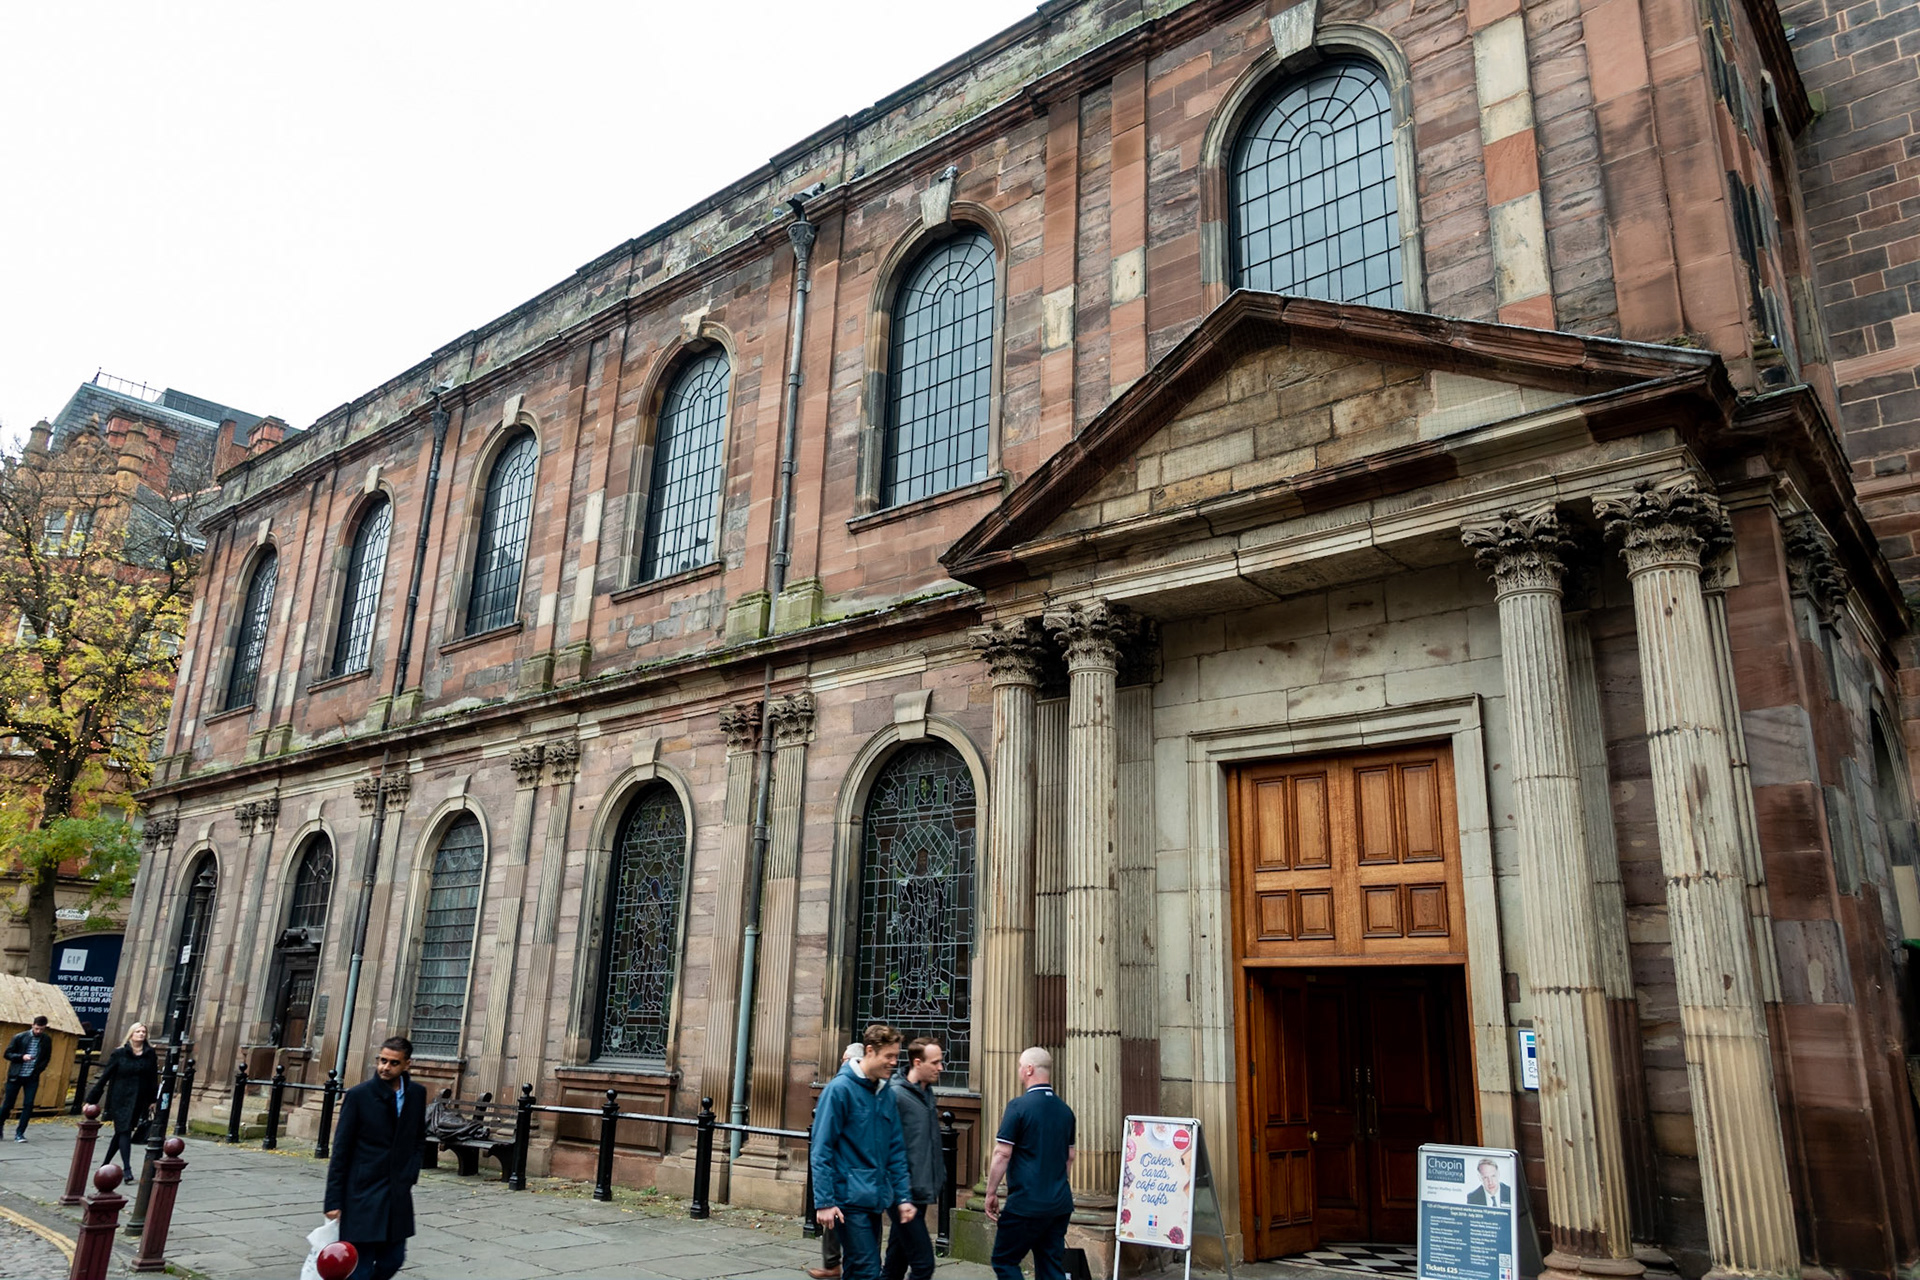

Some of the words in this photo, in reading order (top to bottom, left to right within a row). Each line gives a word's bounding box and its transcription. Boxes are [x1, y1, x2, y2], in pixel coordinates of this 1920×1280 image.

[1140, 1152, 1174, 1168] Cakes,
[1427, 1157, 1463, 1171] Chopin
[1141, 1167, 1170, 1180] cards,
[1136, 1179, 1156, 1193] café
[1158, 1181, 1177, 1193] and
[1141, 1192, 1168, 1206] crafts
[1425, 1263, 1446, 1272] Tickets
[1447, 1266, 1458, 1274] £25
